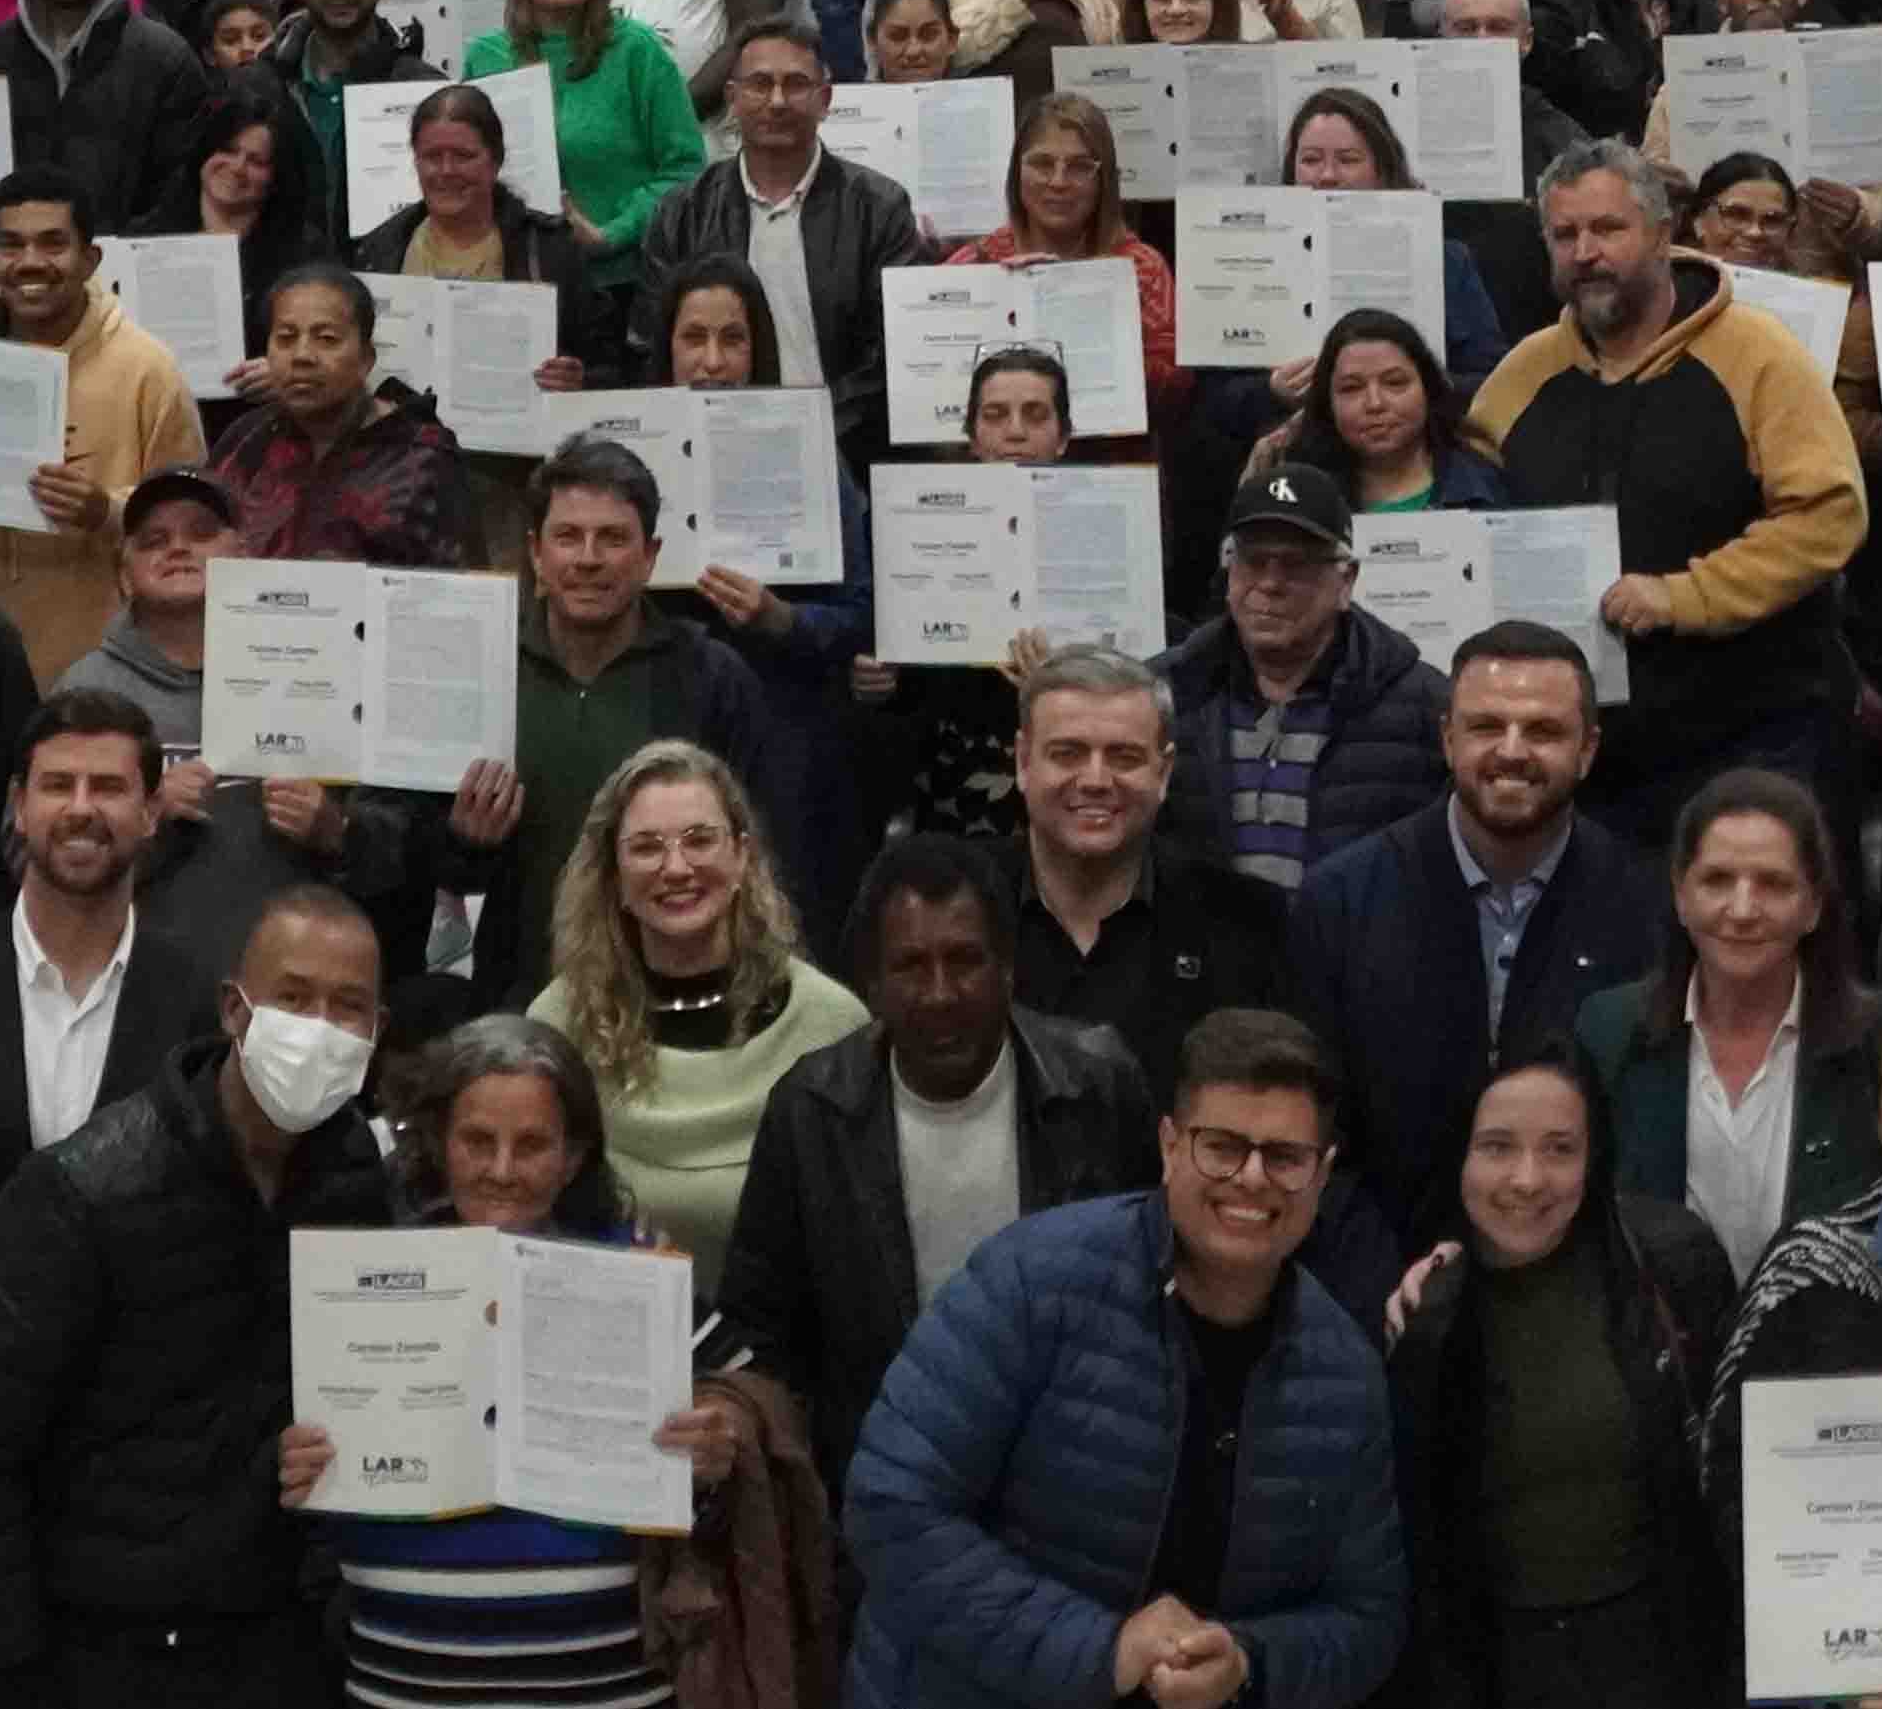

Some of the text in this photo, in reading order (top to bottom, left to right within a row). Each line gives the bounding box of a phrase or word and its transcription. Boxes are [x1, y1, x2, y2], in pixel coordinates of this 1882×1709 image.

[373, 1272, 426, 1291] LAGES
[363, 1456, 404, 1473] LAR
[1823, 1628, 1867, 1648] LAR
